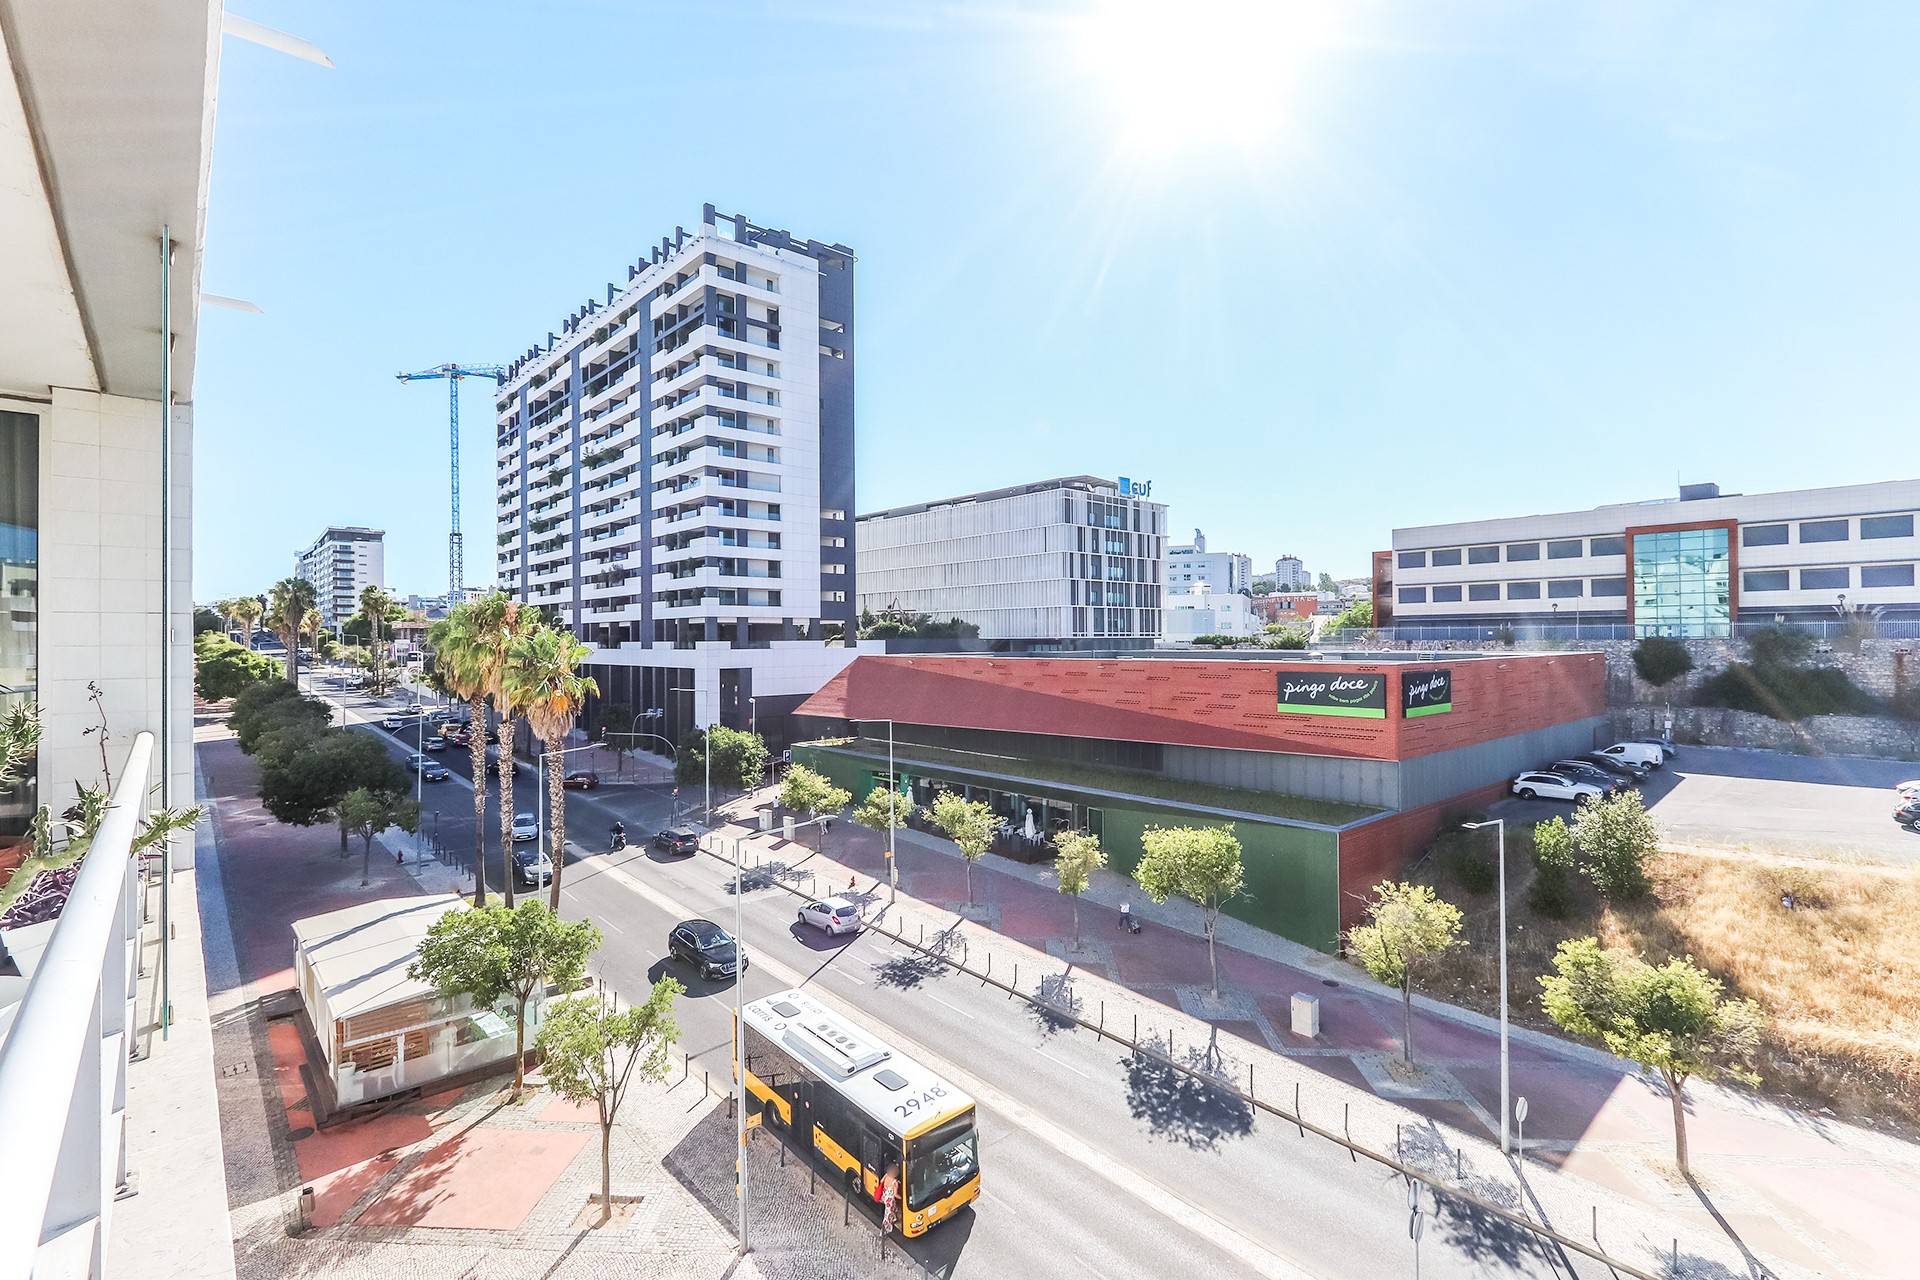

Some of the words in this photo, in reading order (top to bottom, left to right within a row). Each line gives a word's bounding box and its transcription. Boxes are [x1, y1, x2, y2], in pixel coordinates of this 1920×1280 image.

[1283, 679, 1326, 701] pingo
[1330, 676, 1369, 691] doce
[1408, 680, 1429, 705] pingo
[1430, 674, 1446, 690] doce
[748, 1004, 773, 1022] carris
[894, 1087, 947, 1118] 2948
